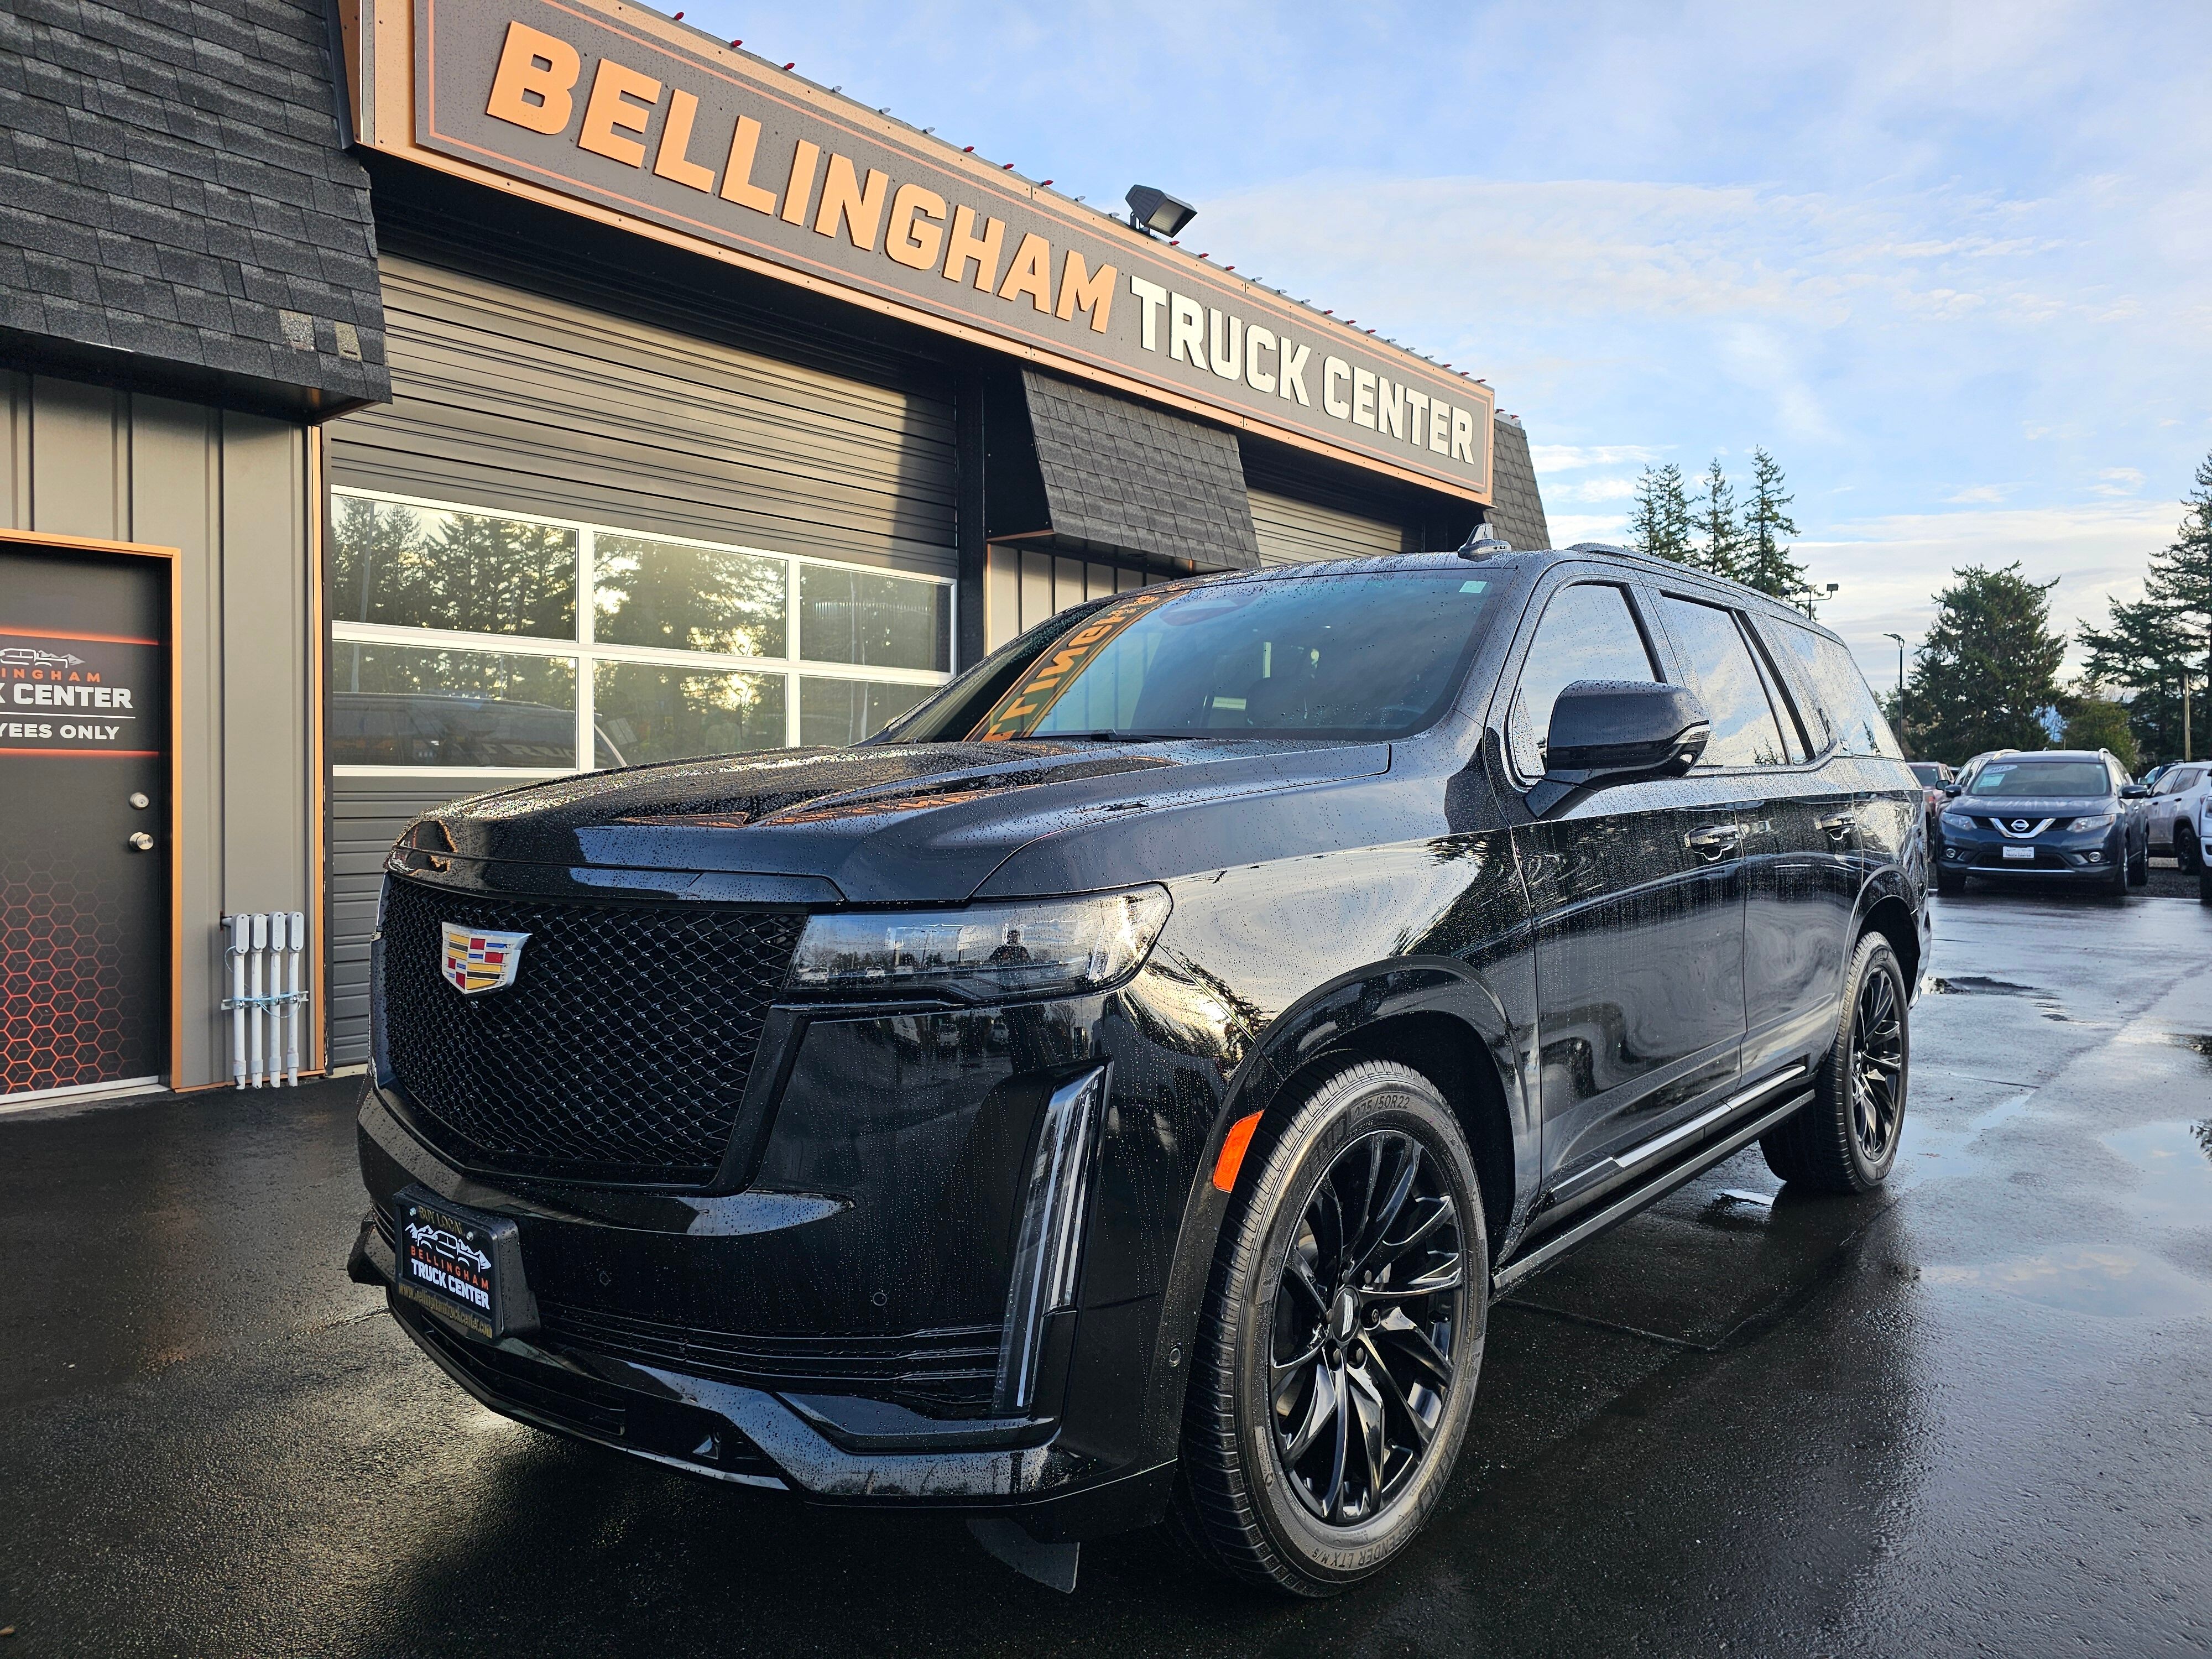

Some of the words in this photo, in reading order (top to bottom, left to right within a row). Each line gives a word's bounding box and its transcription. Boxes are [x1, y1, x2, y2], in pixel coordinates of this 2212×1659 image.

[486, 20, 1117, 333] BELLINGHAM
[1130, 275, 1312, 408] TRUCK
[1323, 354, 1474, 465] CENTER
[2, 667, 101, 682] INGHAM
[13, 682, 133, 708] CENTER
[60, 724, 120, 740] ONLY
[418, 1205, 435, 1224] BUY
[411, 1245, 489, 1290] BELLINGHAM
[411, 1258, 447, 1288] TRUCK
[448, 1275, 491, 1310] CENTER
